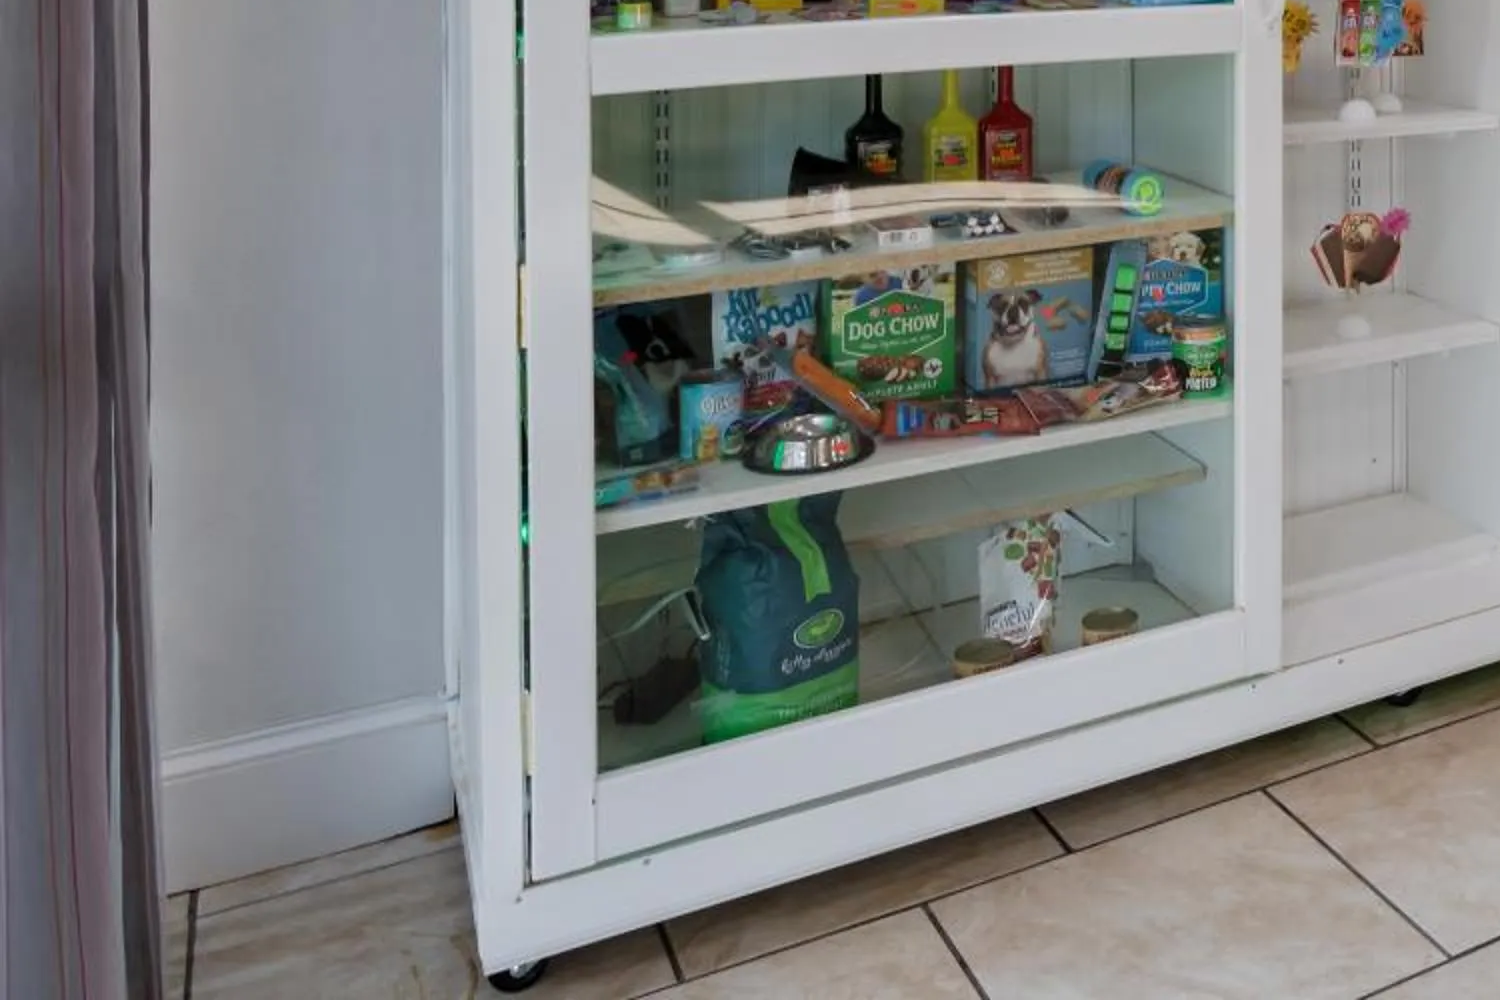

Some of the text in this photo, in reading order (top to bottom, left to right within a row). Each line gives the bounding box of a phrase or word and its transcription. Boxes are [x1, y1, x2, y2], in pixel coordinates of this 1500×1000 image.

[1166, 280, 1201, 295] CHOW
[722, 291, 815, 344] Kaboodl
[849, 312, 939, 342] DOG CHOW
